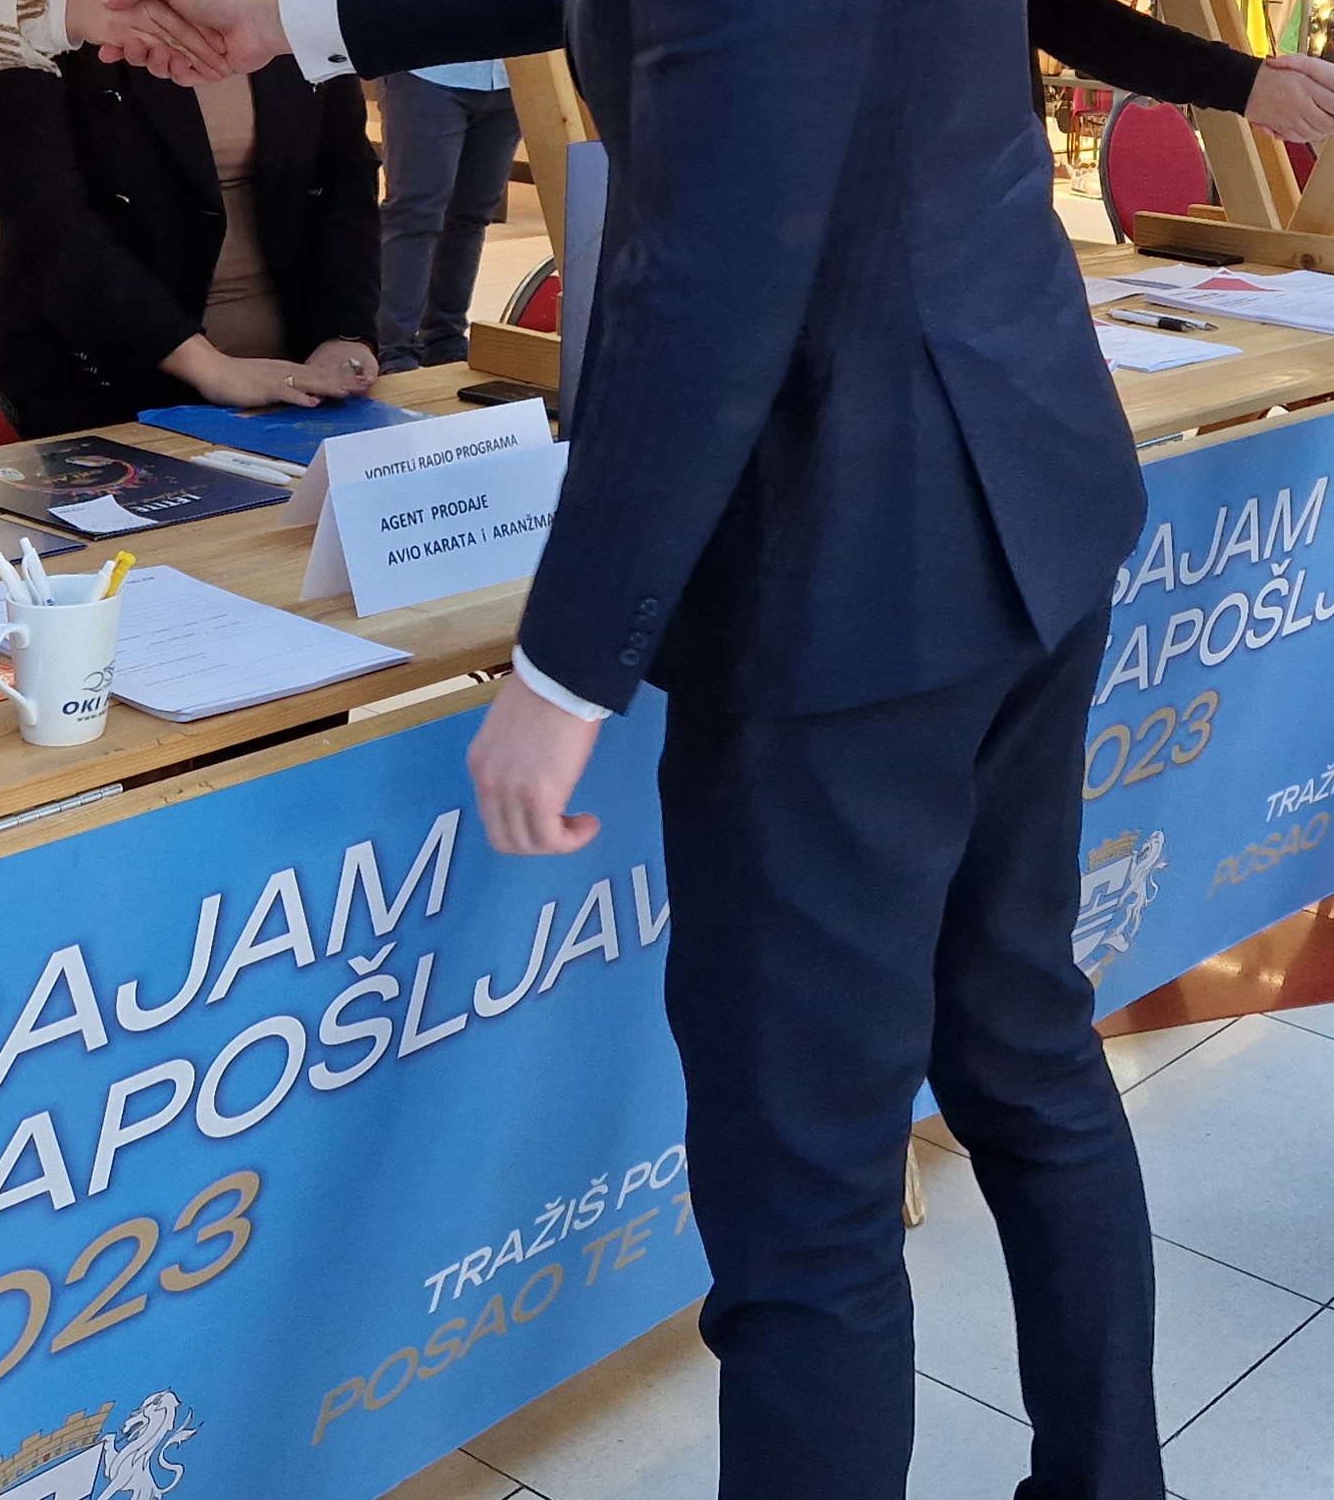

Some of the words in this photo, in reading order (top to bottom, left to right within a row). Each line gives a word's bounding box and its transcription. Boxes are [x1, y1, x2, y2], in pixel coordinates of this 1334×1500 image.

[418, 452, 454, 470] RADIO
[455, 434, 519, 460] PROGRAMA
[380, 509, 425, 533] AGENT
[430, 494, 490, 521] PRODAJE
[387, 545, 421, 566] AVIO
[423, 531, 477, 557] KARATA
[481, 528, 487, 543] i
[492, 513, 556, 540] ARANŽMA
[62, 696, 102, 716] OKI
[1081, 690, 1220, 800] 023
[1206, 811, 1330, 901] POSAO
[423, 1172, 610, 1314] TRAŽIŠ
[311, 1264, 564, 1447] POSAO
[582, 1208, 660, 1287] TE
